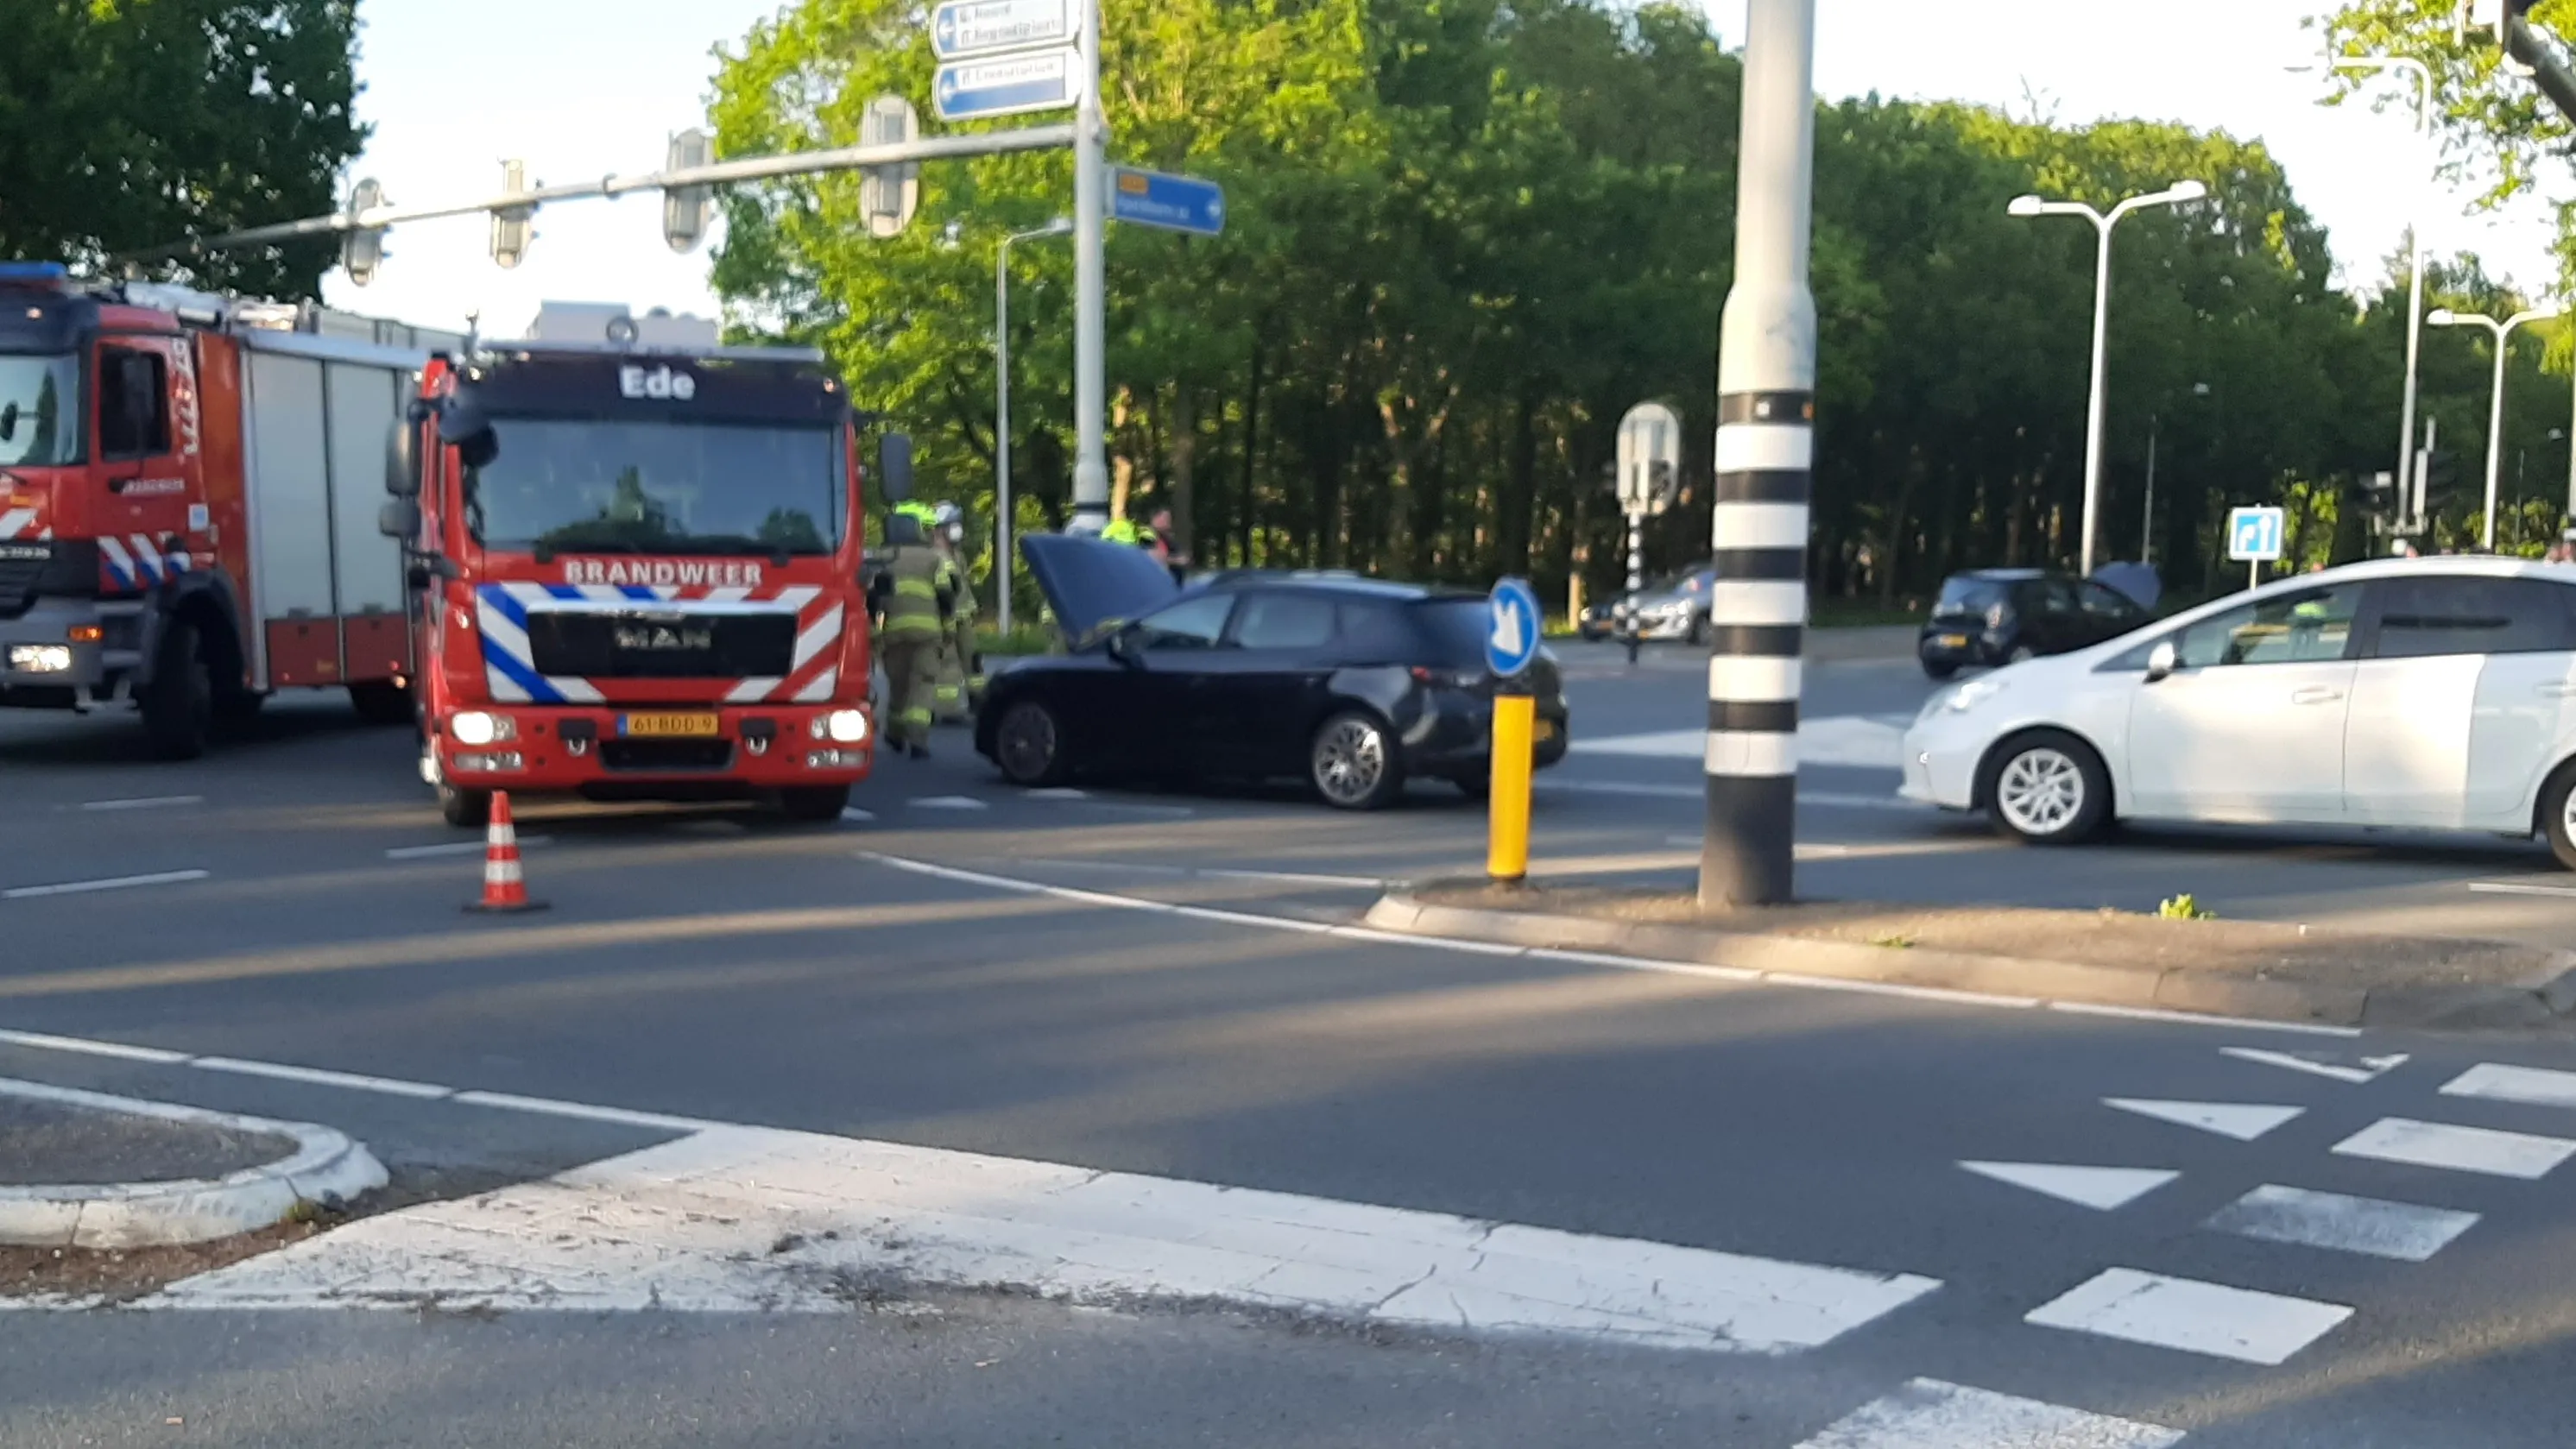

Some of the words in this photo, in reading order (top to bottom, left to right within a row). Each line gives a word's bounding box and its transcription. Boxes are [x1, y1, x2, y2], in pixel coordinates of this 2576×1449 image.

[620, 362, 696, 400] Ede
[565, 558, 762, 585] BRANDWEER
[615, 626, 712, 648] MAN
